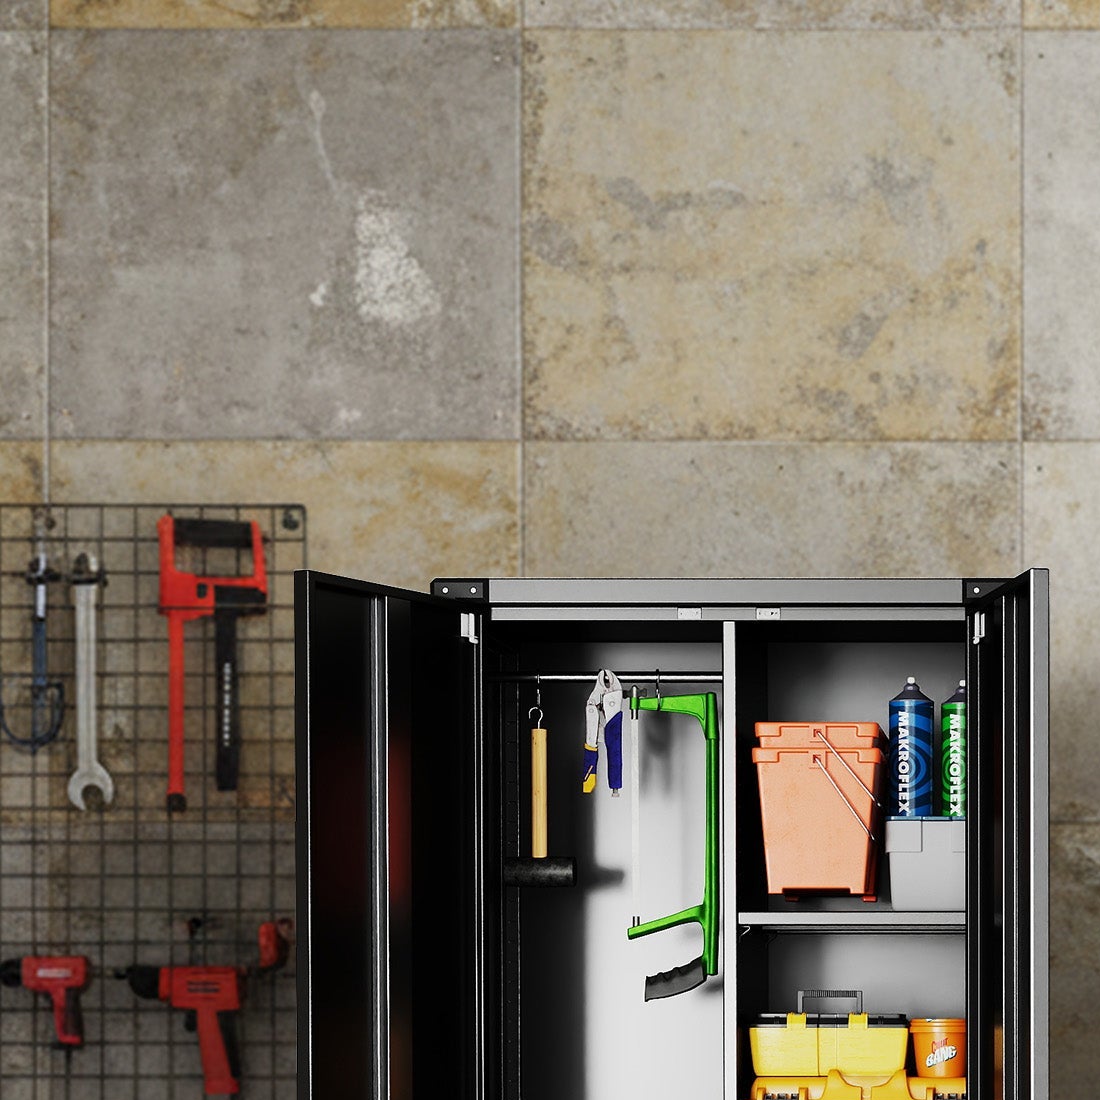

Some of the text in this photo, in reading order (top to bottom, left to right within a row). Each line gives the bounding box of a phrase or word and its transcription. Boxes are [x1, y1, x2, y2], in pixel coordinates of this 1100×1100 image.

[898, 711, 911, 814] MAKROFLEX
[949, 714, 962, 816] MAKROFLEX
[926, 1045, 957, 1068] BANG
